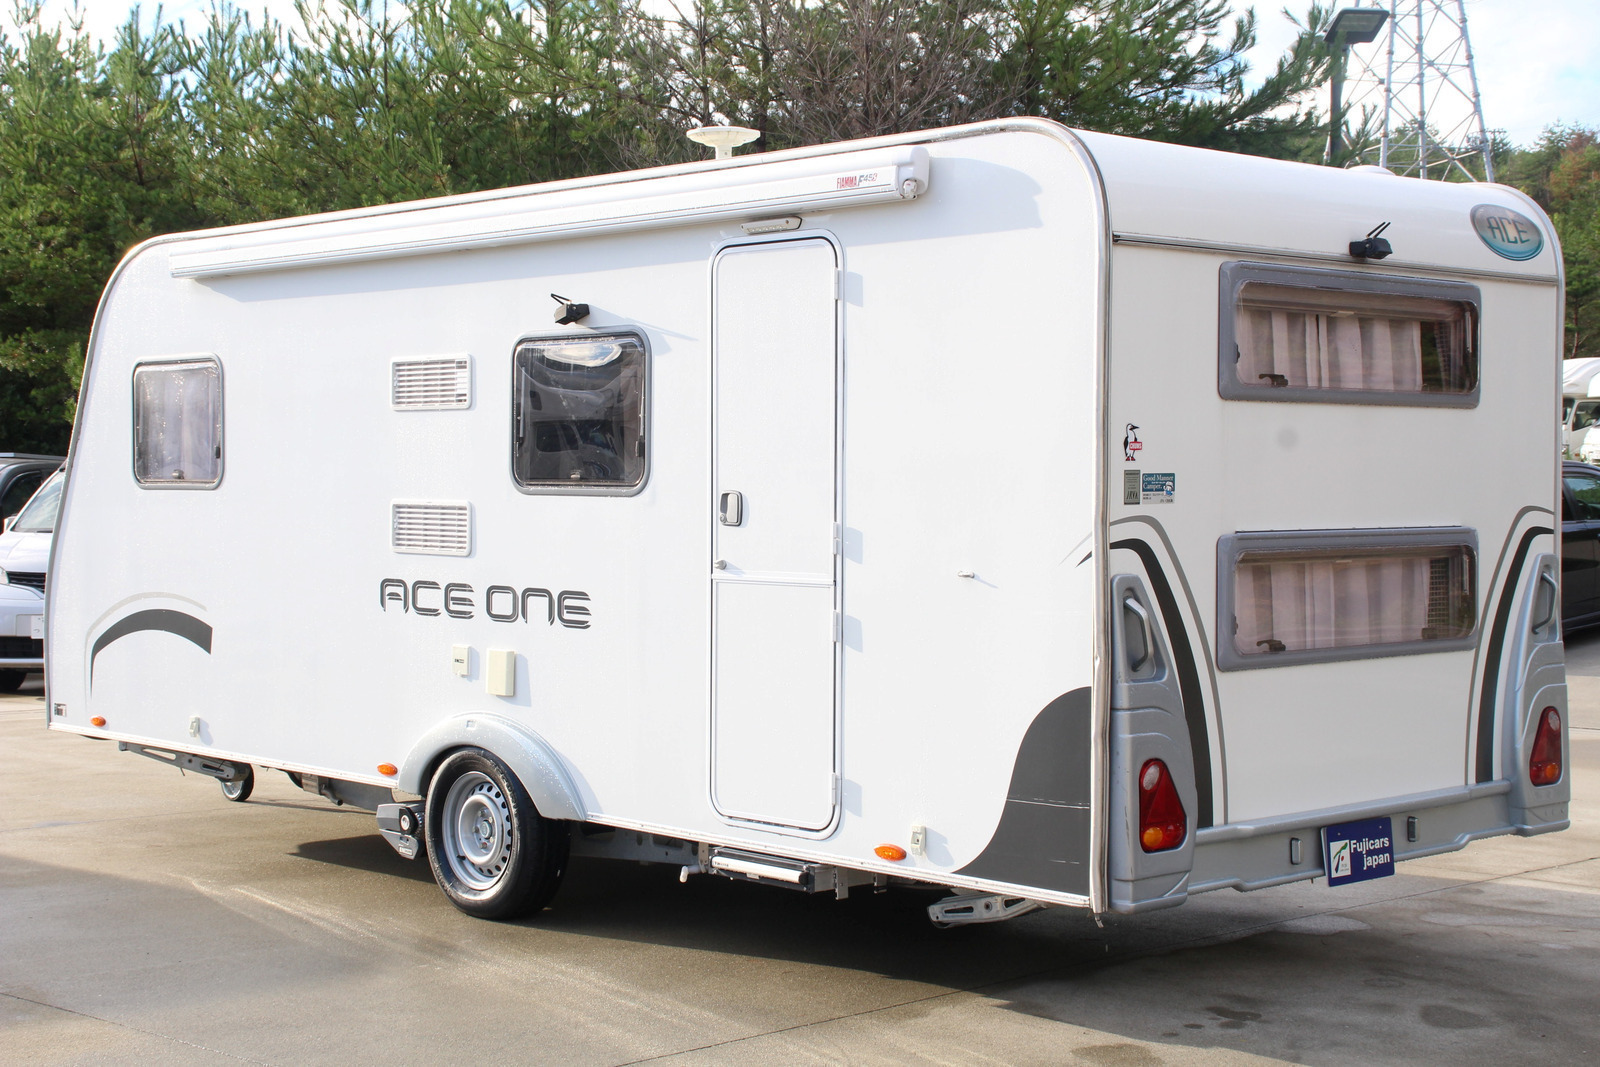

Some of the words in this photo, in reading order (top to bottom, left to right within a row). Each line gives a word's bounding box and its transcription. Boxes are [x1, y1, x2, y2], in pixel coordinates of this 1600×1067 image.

[1487, 216, 1530, 244] ACE
[380, 578, 475, 619] ACE
[485, 585, 592, 630] ONE
[1350, 837, 1390, 854] Fujicars
[1363, 853, 1390, 870] japan
